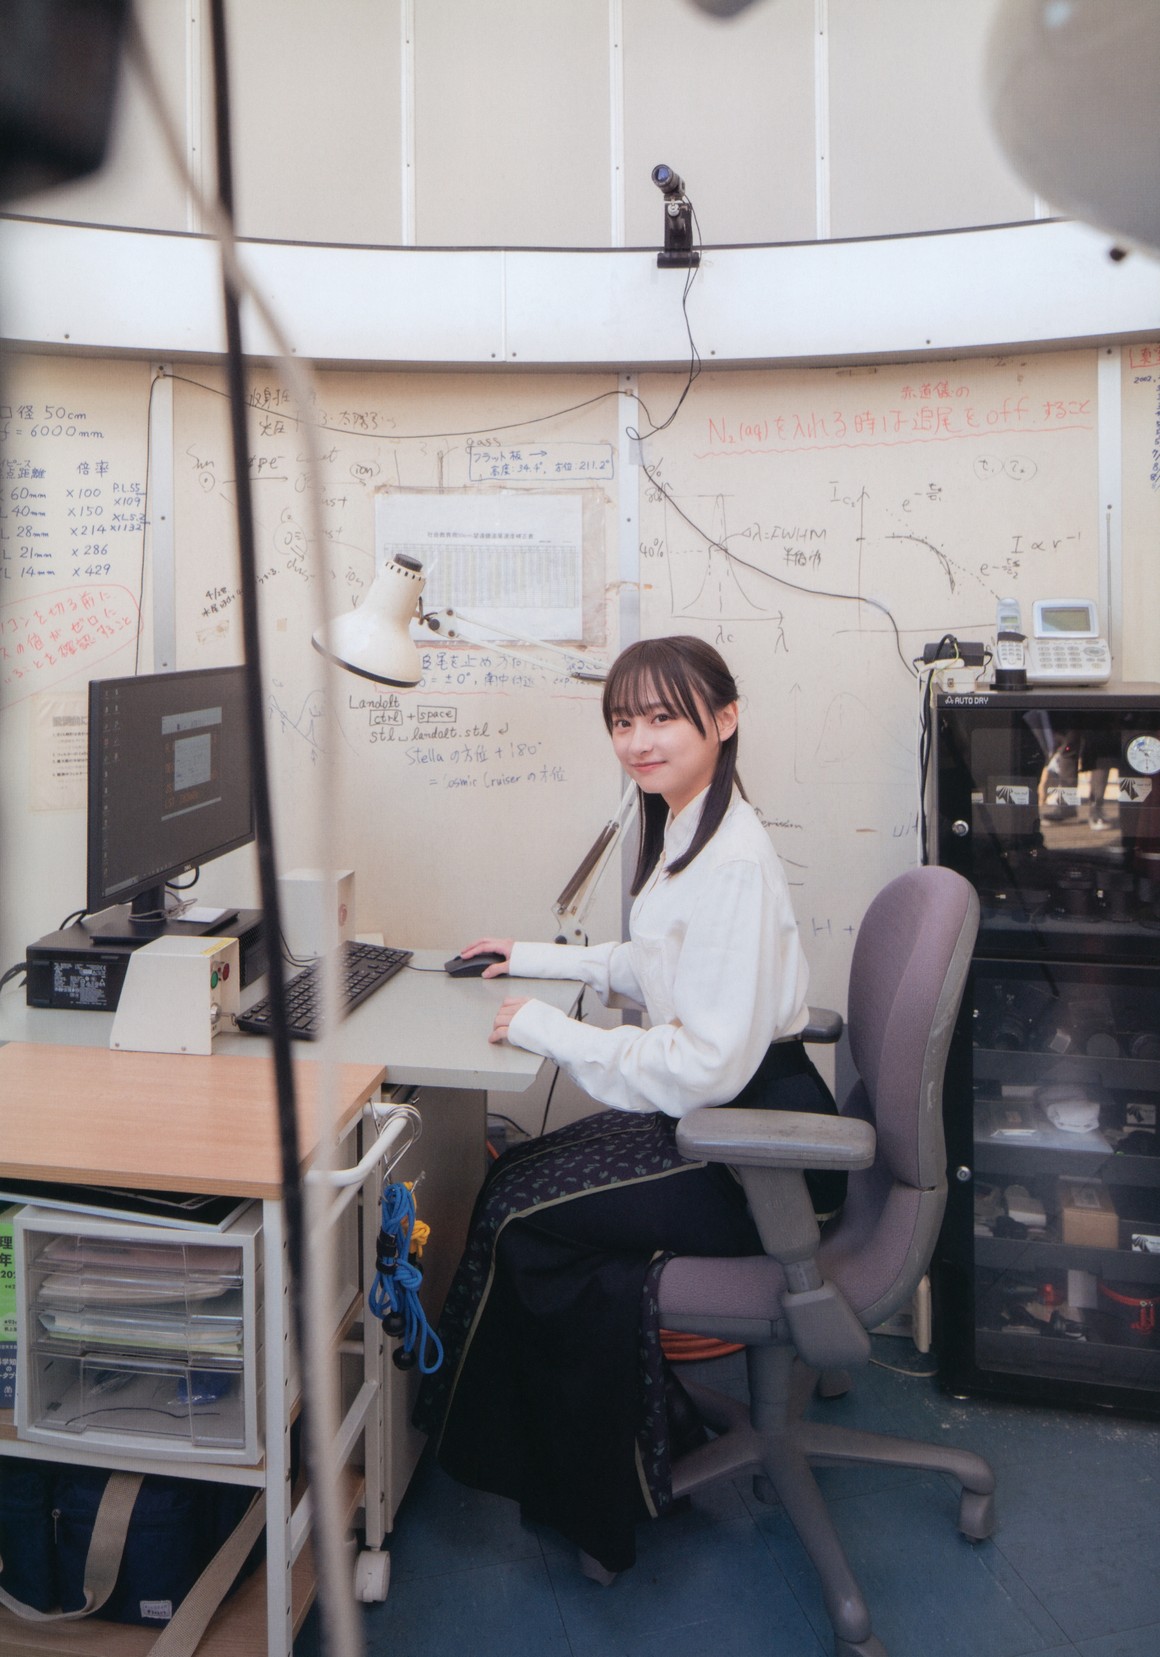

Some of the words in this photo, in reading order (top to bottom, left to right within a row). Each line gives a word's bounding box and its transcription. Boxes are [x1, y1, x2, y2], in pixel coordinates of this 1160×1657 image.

[44, 404, 87, 420] 50cm
[30, 423, 105, 440] 6000mm
[77, 459, 110, 479] 倍率
[10, 486, 47, 501] 60mm
[11, 505, 46, 518] 40mm
[16, 525, 49, 538] 28mm
[19, 546, 52, 559] 21mm
[20, 565, 55, 578] 14mm
[349, 694, 401, 709] Landolt
[374, 712, 400, 726] ctrl
[419, 708, 454, 724] space
[405, 746, 445, 766] Stella
